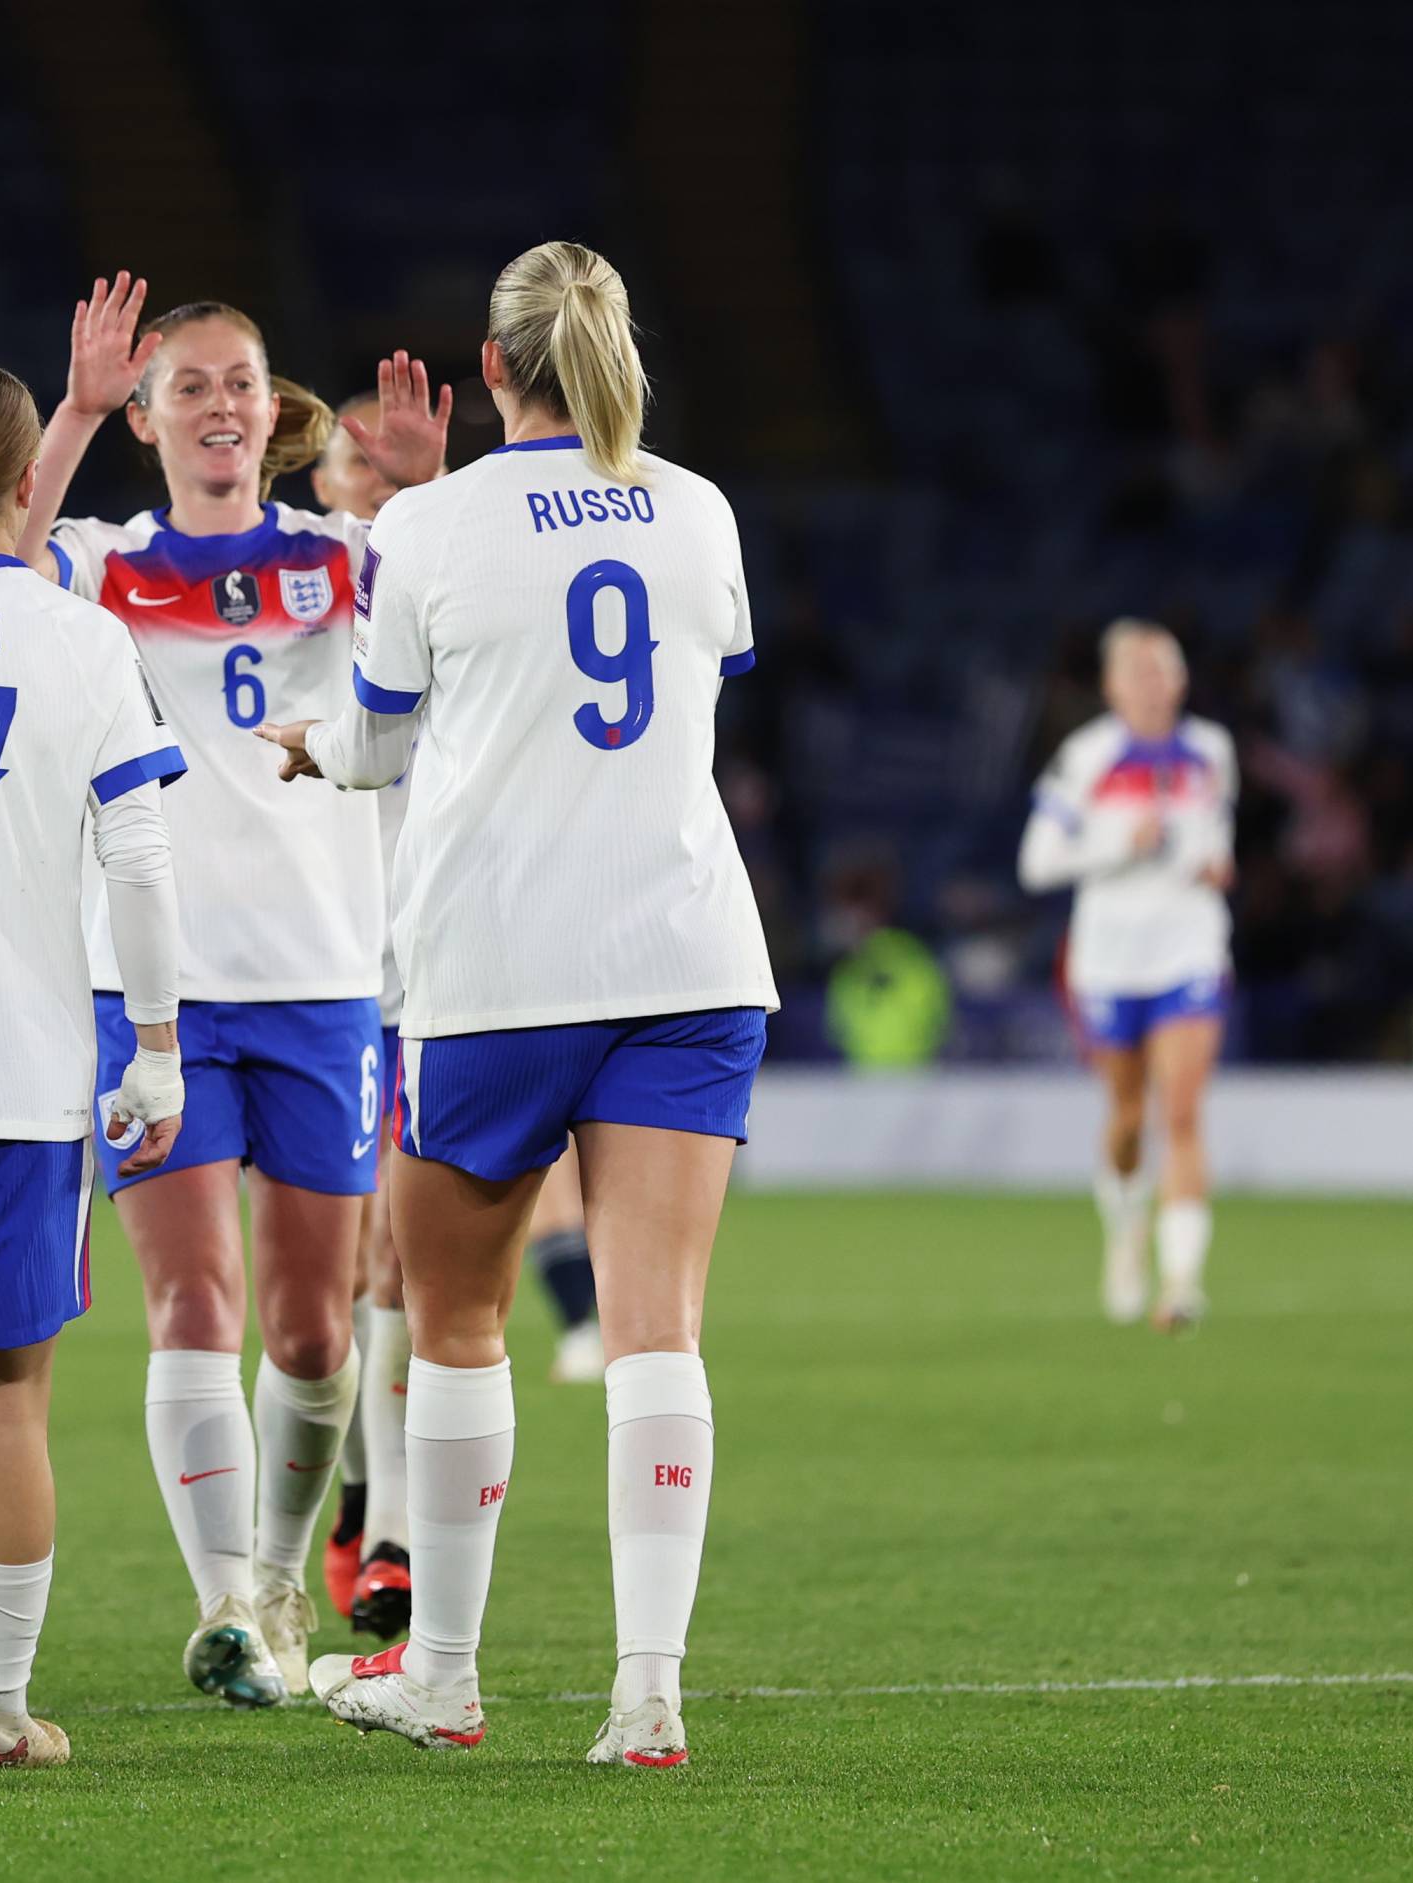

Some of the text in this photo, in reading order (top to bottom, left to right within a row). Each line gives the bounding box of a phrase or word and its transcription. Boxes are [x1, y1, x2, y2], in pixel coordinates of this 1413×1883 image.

[528, 488, 655, 534] RUSSO
[222, 644, 268, 730] 6
[567, 560, 659, 752] 9
[359, 1044, 379, 1135] 6
[479, 1480, 507, 1507] ENG
[654, 1464, 693, 1489] ENG
